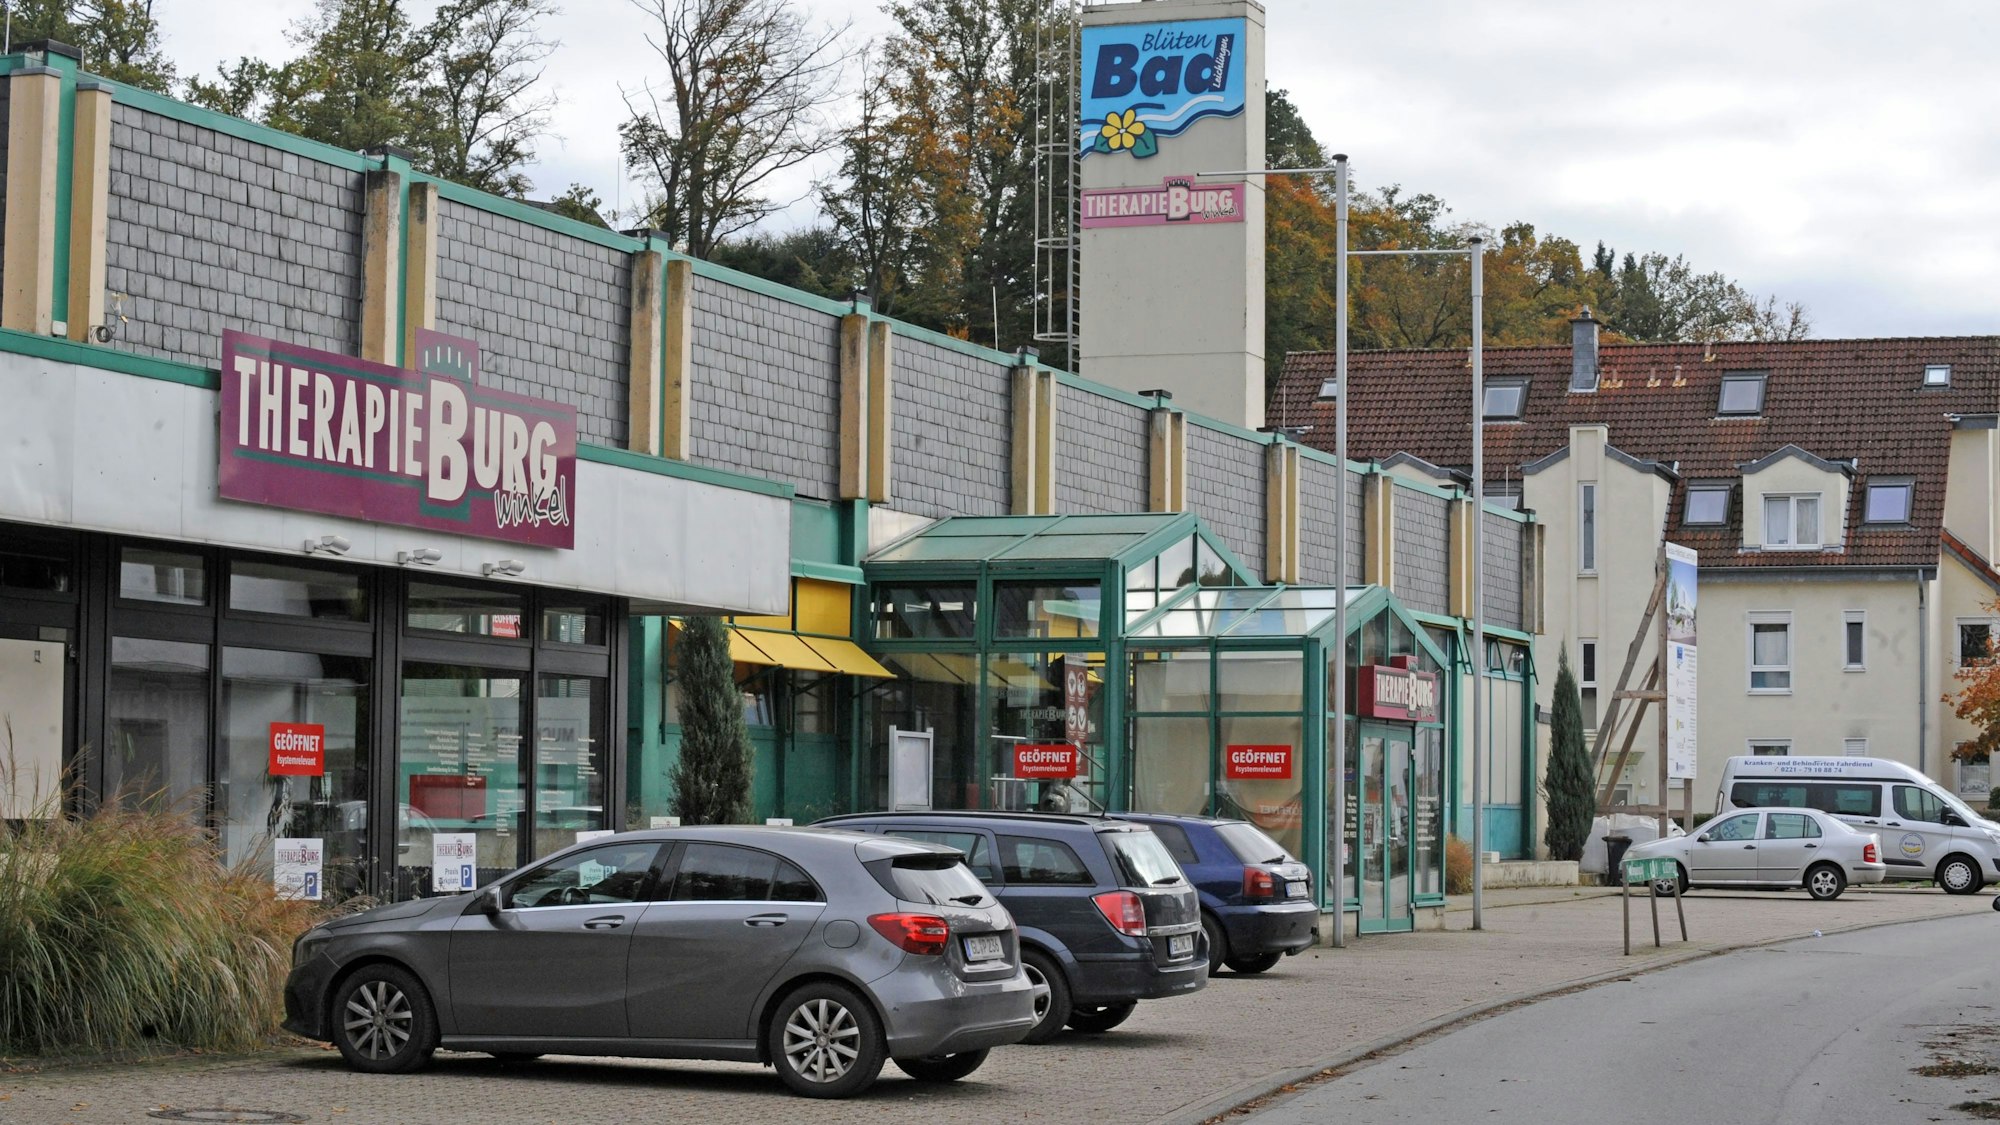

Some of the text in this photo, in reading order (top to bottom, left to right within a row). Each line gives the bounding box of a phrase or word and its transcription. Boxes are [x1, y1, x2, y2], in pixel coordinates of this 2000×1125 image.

[1142, 28, 1212, 52] Blüten
[1091, 33, 1235, 99] Bad
[1212, 36, 1231, 89] Leichlingen
[274, 729, 320, 752] GEÖFFNET
[1019, 749, 1071, 763] GEÖFFNET
[1231, 749, 1286, 764] GEÖFFNET
[1022, 765, 1068, 774] #systemrelevant
[1235, 766, 1282, 774] #systemrelevant
